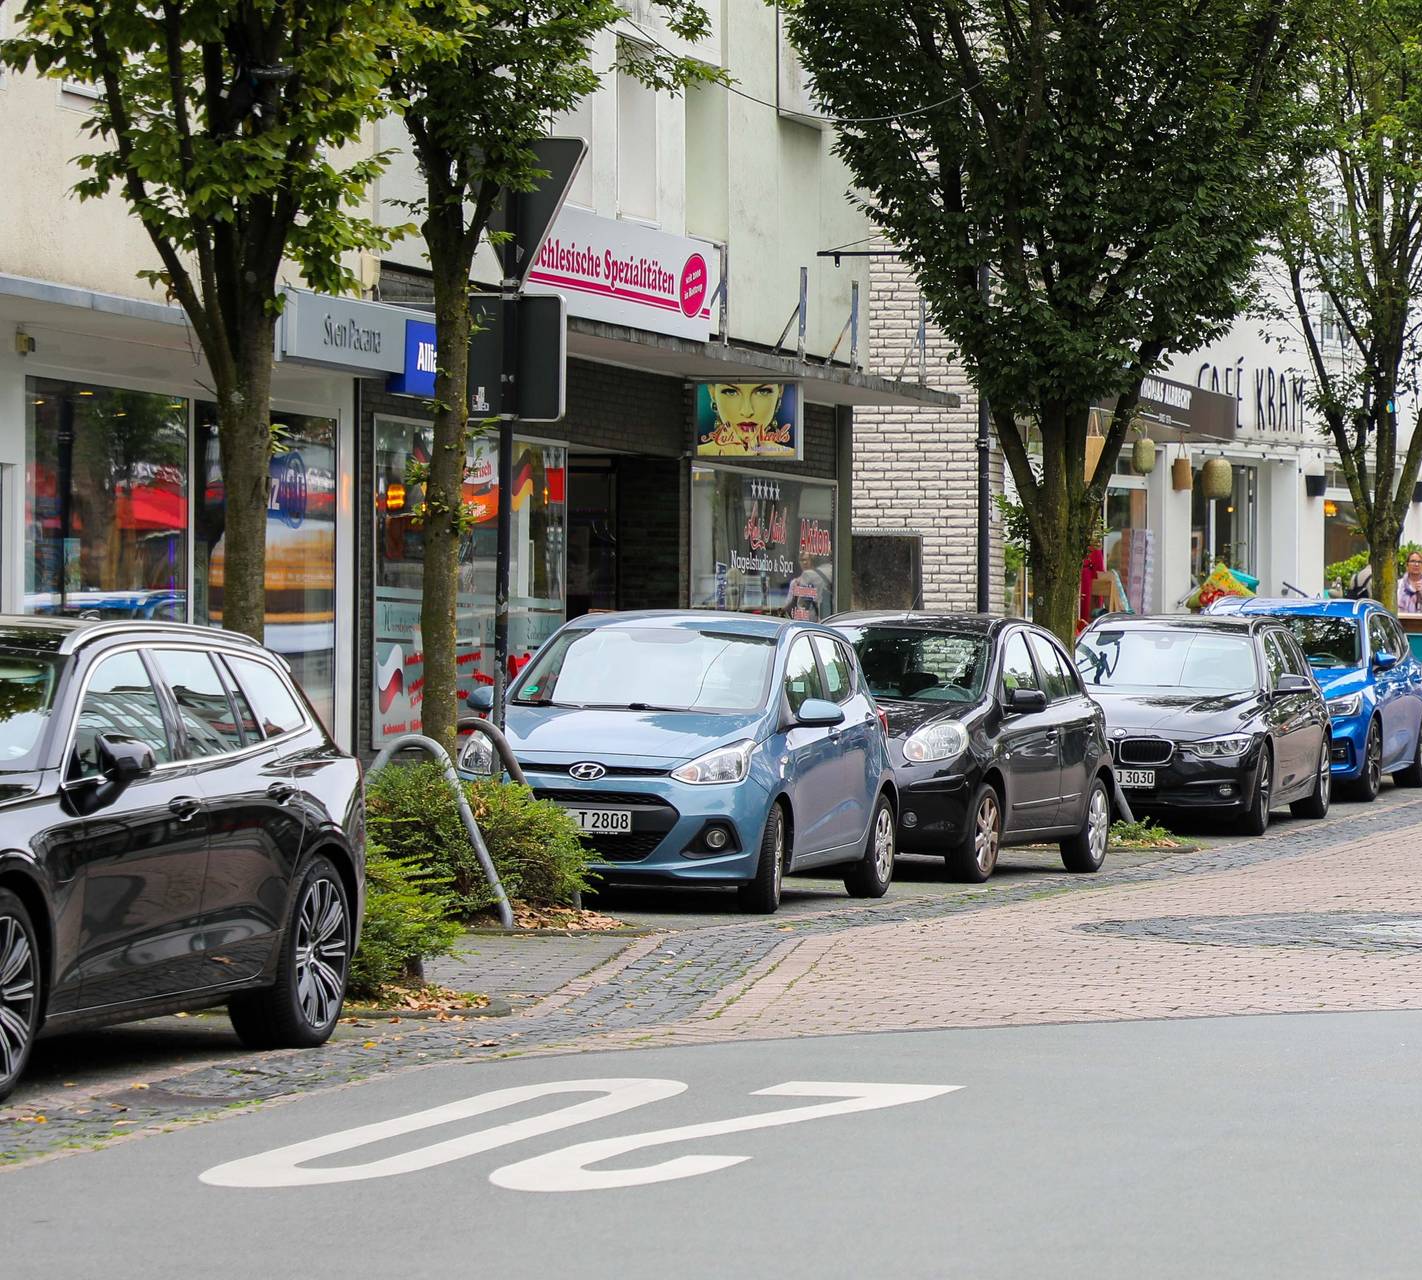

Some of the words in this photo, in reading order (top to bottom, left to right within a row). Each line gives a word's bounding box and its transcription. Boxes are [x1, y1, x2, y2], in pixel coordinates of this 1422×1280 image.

[603, 249, 675, 295] Spezialitäten
[1255, 366, 1305, 435] KRAM
[731, 550, 773, 573] Nagelstudio
[779, 557, 794, 577] Spa
[1126, 771, 1154, 784] 3030
[578, 811, 588, 828] T
[591, 812, 629, 830] 2808
[199, 1077, 967, 1192] 20
